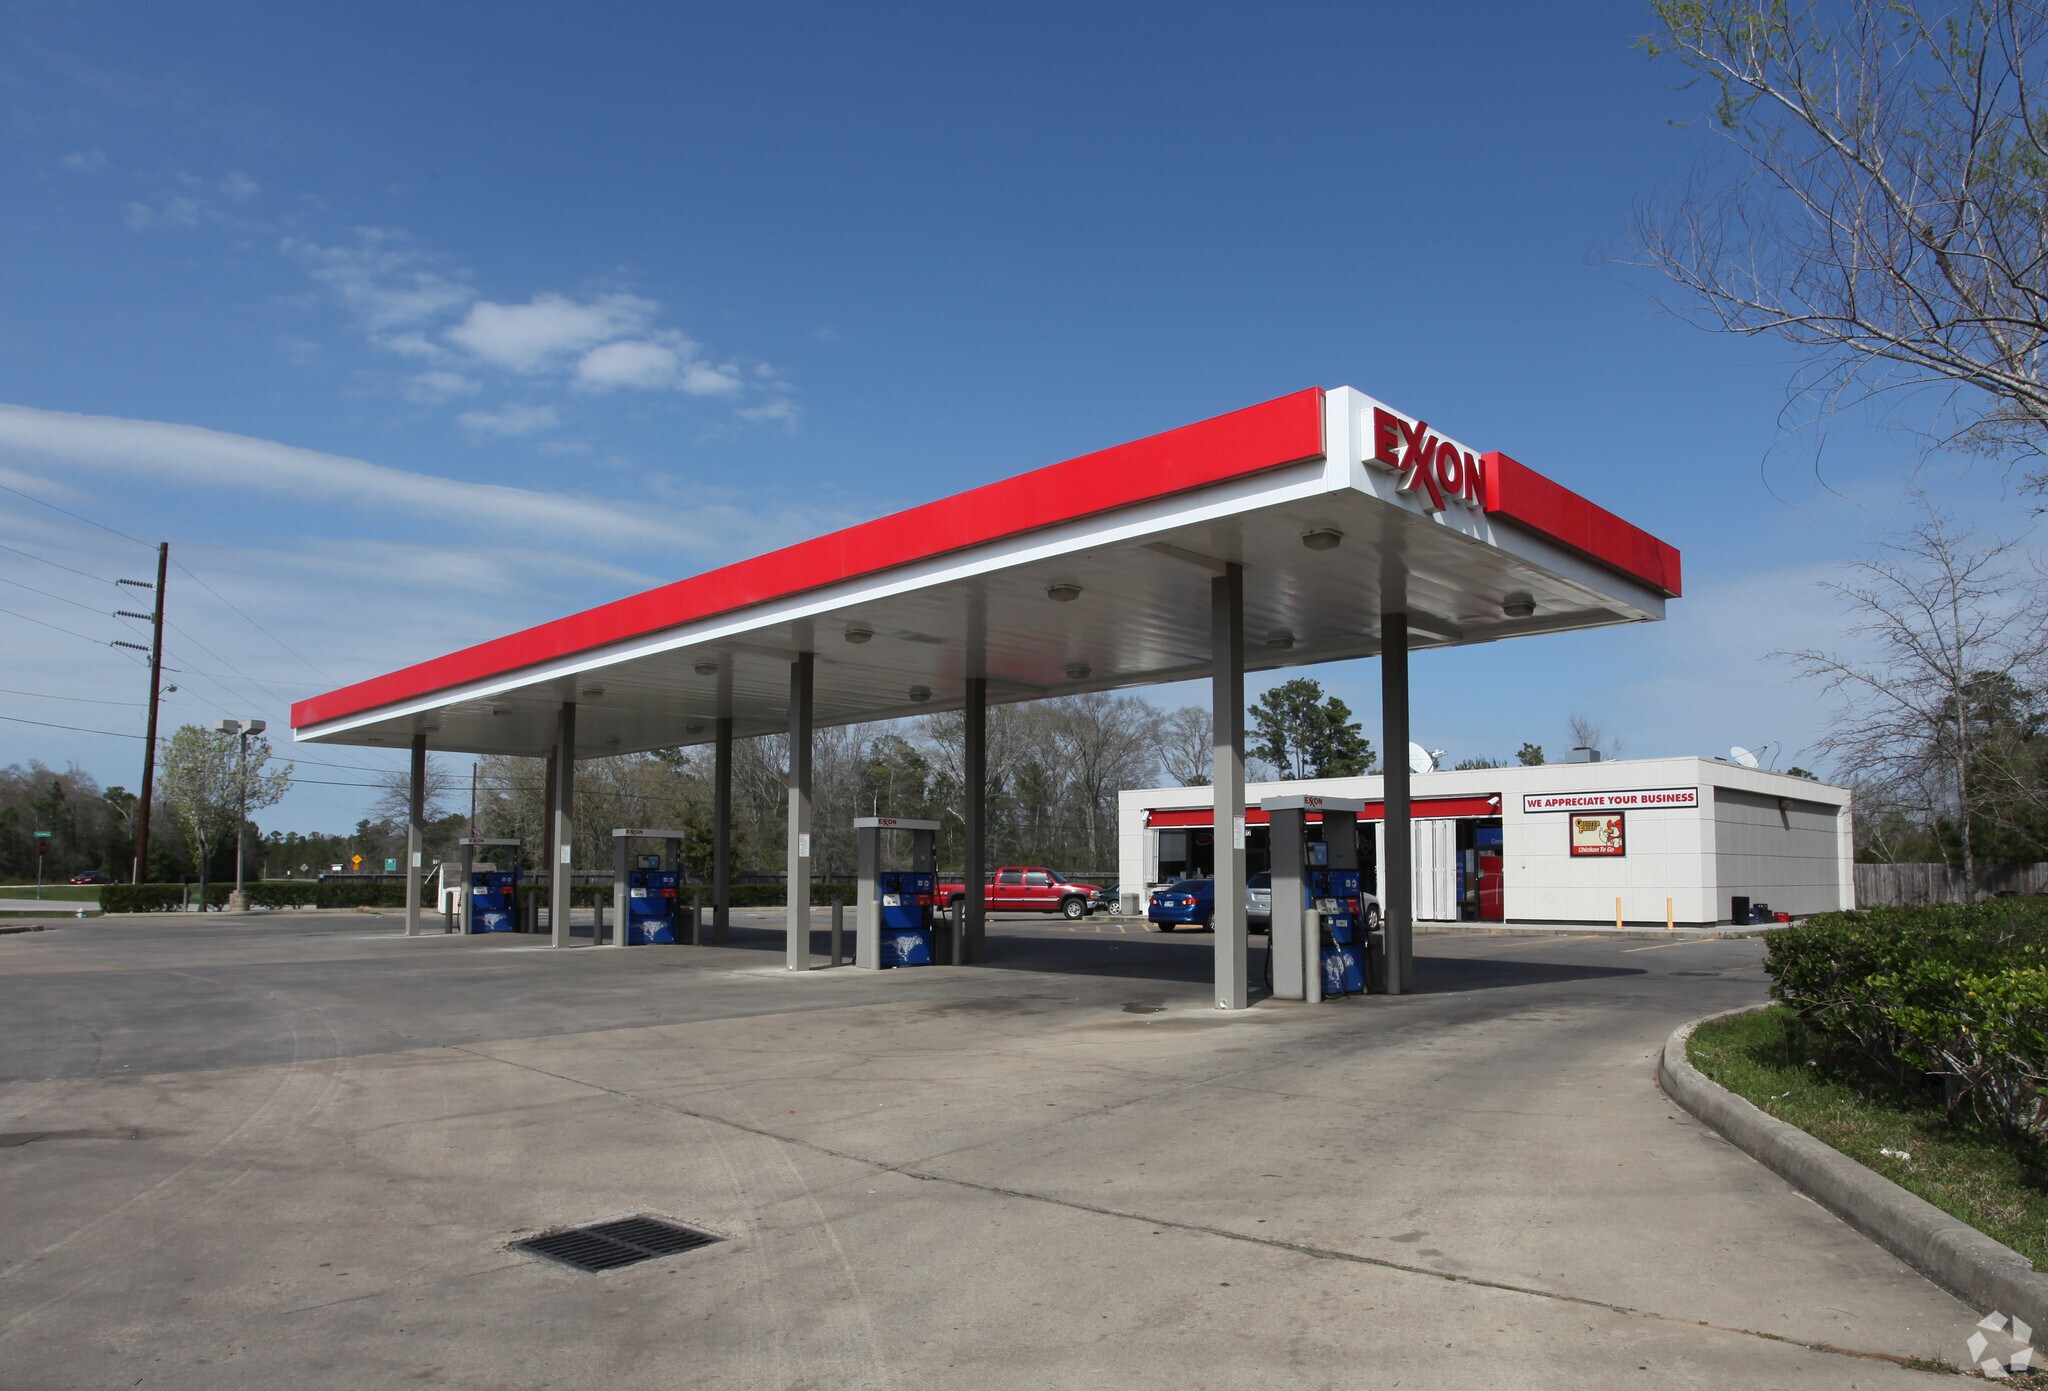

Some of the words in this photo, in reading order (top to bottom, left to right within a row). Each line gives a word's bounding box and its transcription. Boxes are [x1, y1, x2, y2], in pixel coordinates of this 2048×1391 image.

[1373, 406, 1487, 512] EXXON
[1304, 796, 1323, 807] EXXON
[1527, 799, 1542, 808] WE
[1544, 796, 1605, 807] APPRECIATE
[1607, 795, 1638, 805] YOUR
[1641, 793, 1694, 804] BUSINESS
[878, 818, 897, 827] EXXON
